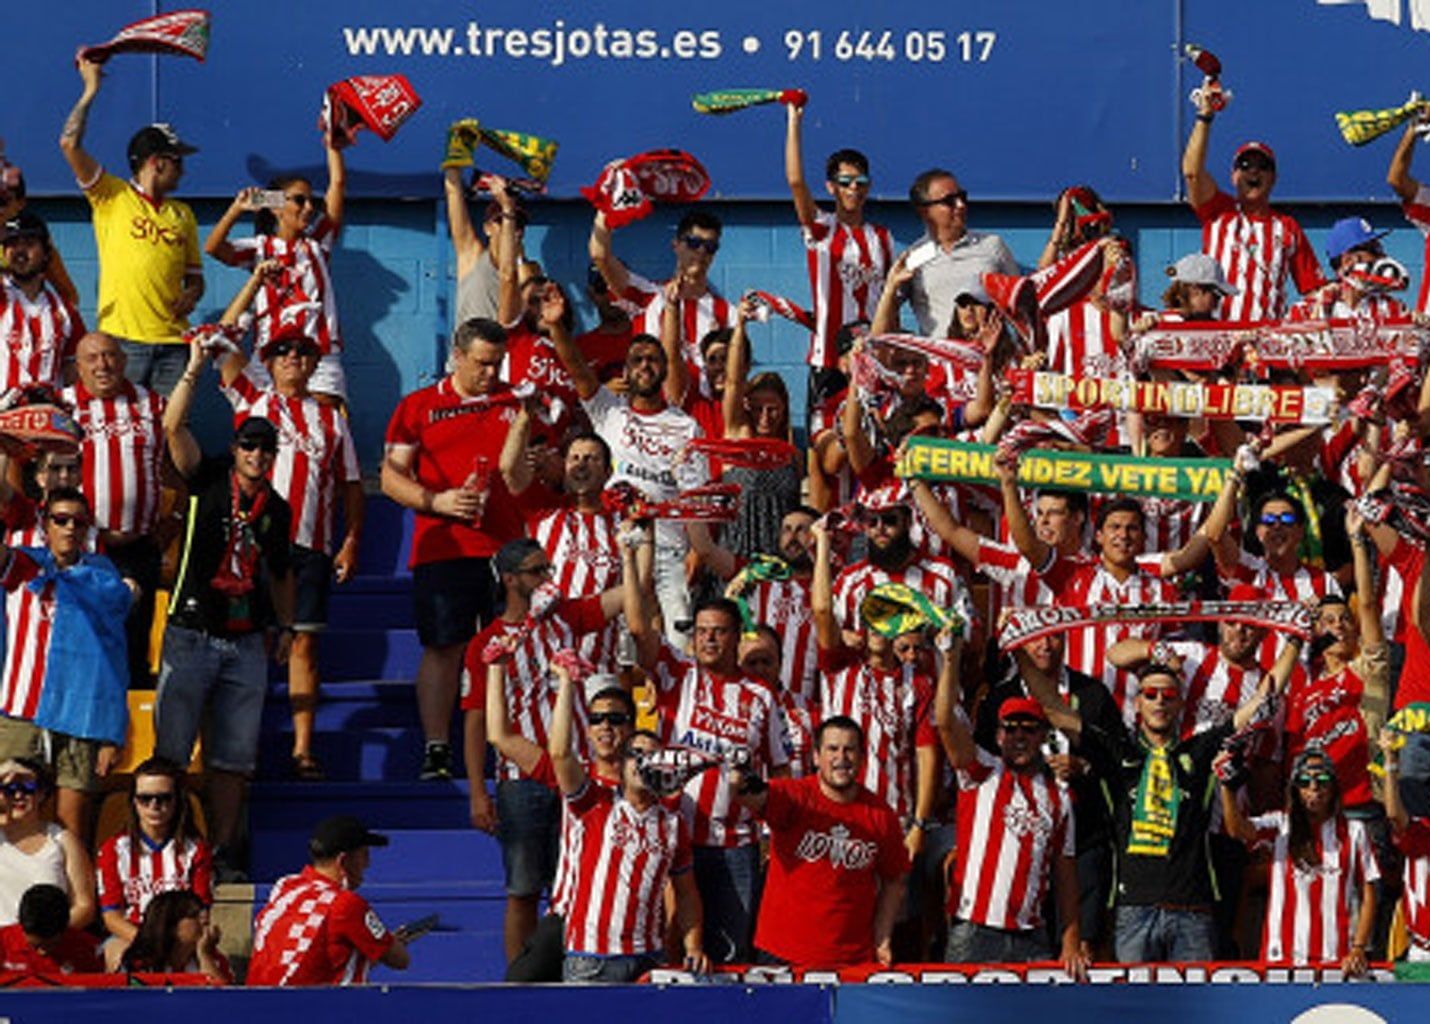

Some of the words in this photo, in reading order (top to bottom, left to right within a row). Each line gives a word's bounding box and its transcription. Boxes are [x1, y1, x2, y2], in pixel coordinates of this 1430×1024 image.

[344, 21, 721, 65] www.tresjotas.es
[785, 30, 820, 59] 91
[835, 31, 895, 60] 644
[905, 31, 945, 61] 05
[958, 32, 995, 61] 17
[1036, 371, 1202, 414] SPORTING
[1203, 385, 1302, 418] LIBRE
[912, 445, 1093, 487] FERNNDEZ
[1100, 461, 1178, 494] VETE
